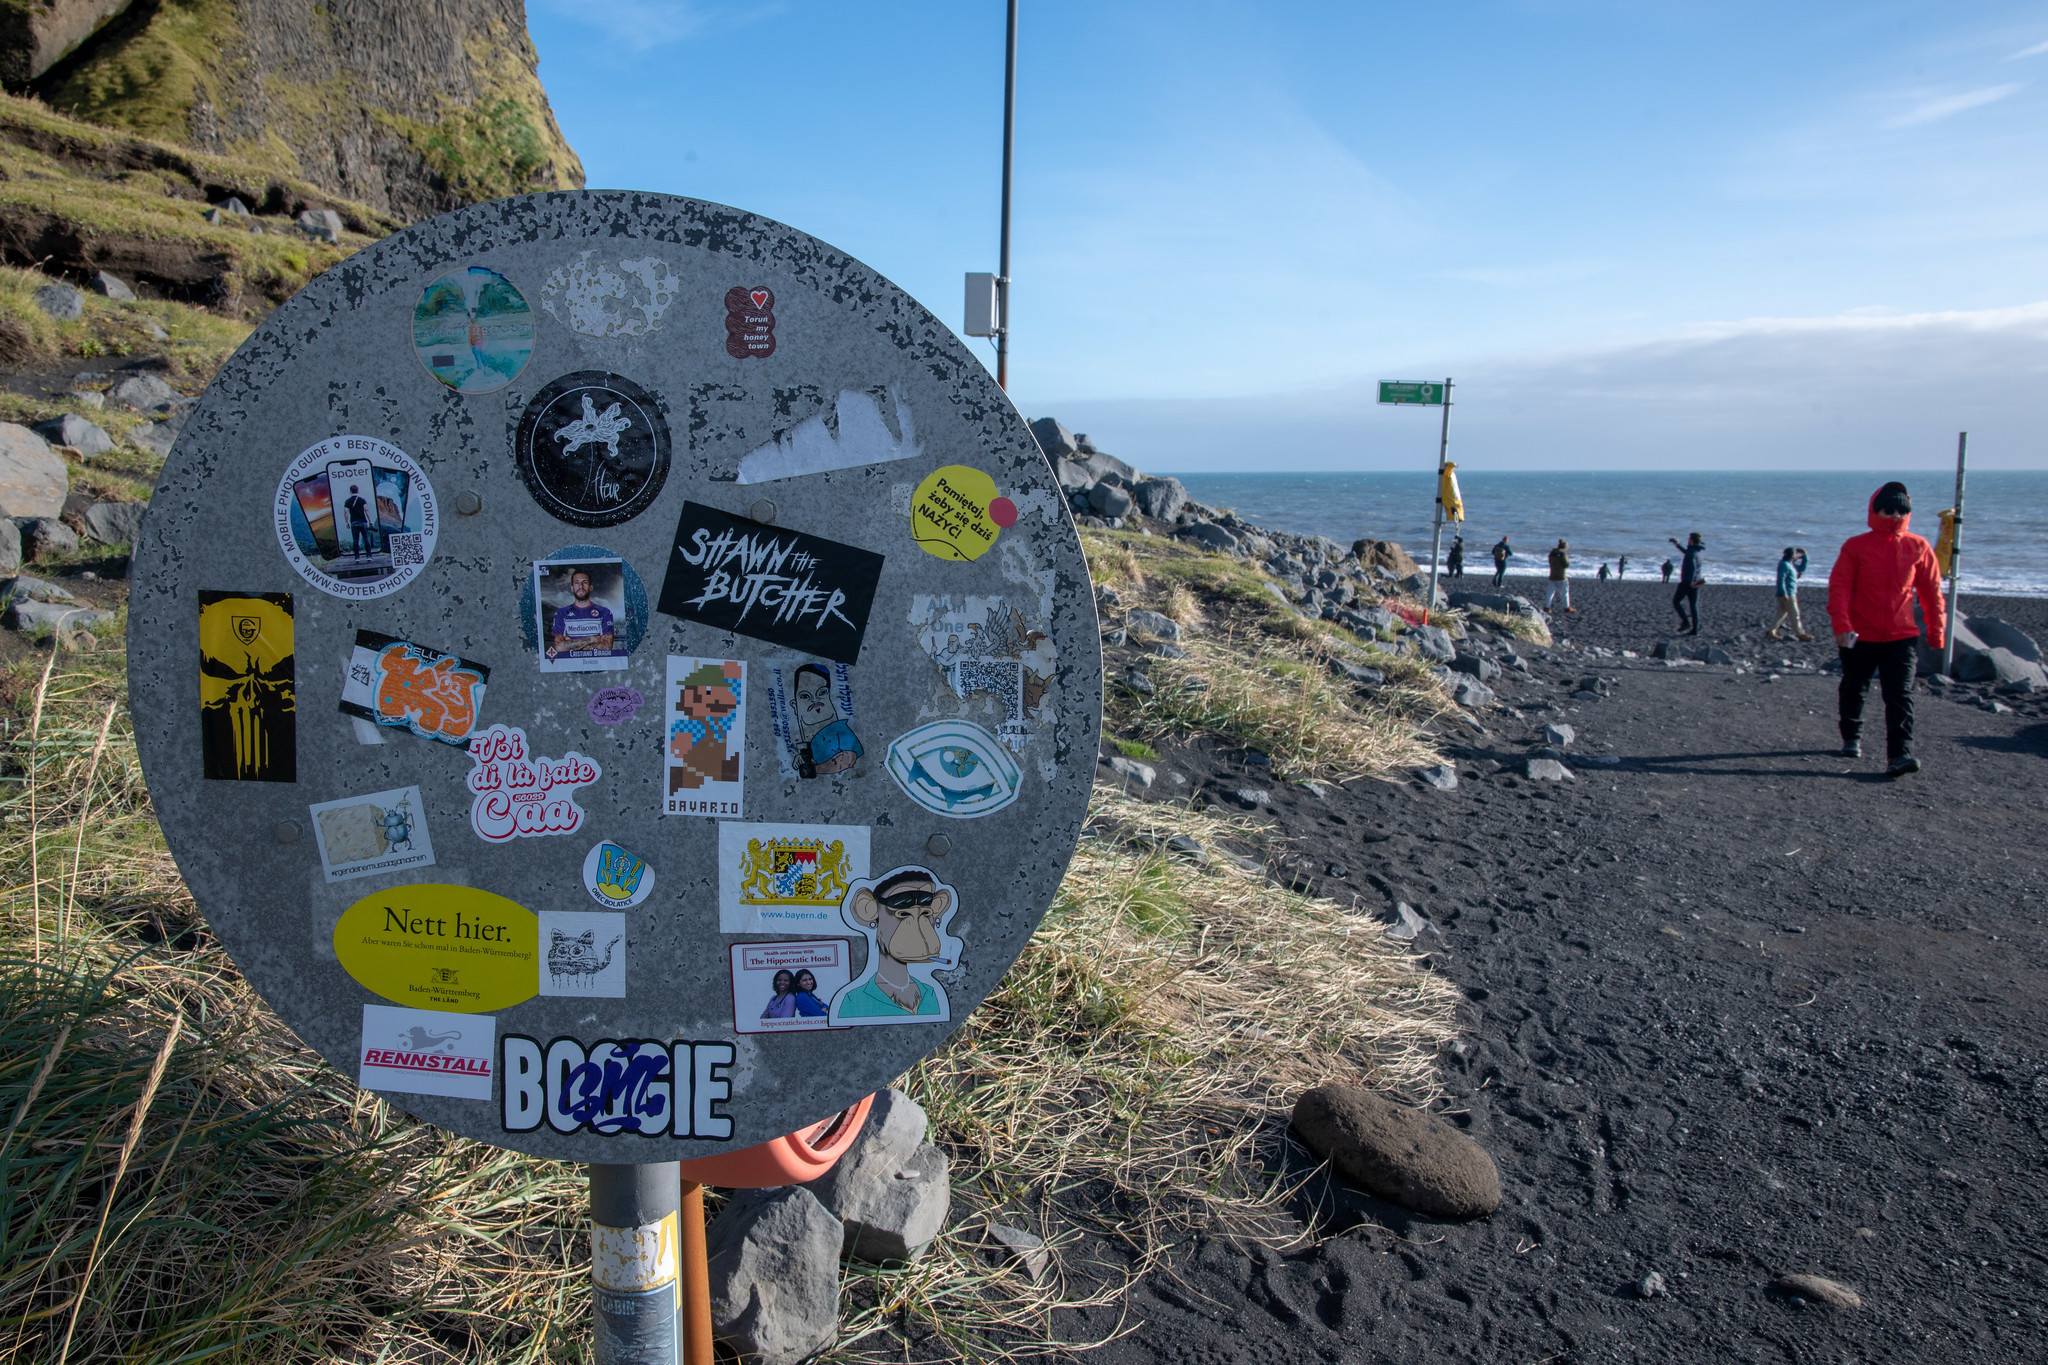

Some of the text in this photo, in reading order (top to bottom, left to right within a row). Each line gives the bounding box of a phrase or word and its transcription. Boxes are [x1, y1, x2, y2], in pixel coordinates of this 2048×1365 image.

[744, 315, 769, 323] Toruń
[755, 325, 769, 333] my
[743, 333, 769, 341] honey
[331, 467, 369, 480] spoter
[277, 444, 330, 553] MOBILE PHOTO GUIDE
[347, 439, 434, 537] BEST SHOOTING POINTS
[936, 477, 985, 520] Pamiętaj,
[918, 503, 962, 539] NAŻYĆ!
[928, 490, 994, 541] żeby się dziś
[678, 527, 823, 576] SHAWN THE
[303, 566, 413, 597] WWW.SPOTER.PHOTO
[682, 567, 857, 632] BUTCHER
[568, 623, 599, 633] Mediacom
[469, 730, 524, 764] Voi
[472, 757, 596, 791] di là fate
[668, 800, 738, 814] BAVARIO
[591, 887, 634, 908] OBEC BOLATICE
[383, 906, 512, 943] Nett hier.
[760, 911, 828, 920] www.bayern.de
[361, 936, 380, 945] Aber
[381, 939, 402, 947] waren
[402, 940, 413, 948] Sie
[413, 941, 435, 950] schon
[435, 943, 449, 951] mal
[459, 945, 532, 961] Baden-Württemberg?
[766, 956, 809, 965] Hippocratic
[810, 955, 831, 963] Hosts
[408, 984, 481, 1000] Baden-Württemberg
[760, 1019, 827, 1028] hippocratichosts.com
[365, 1049, 492, 1073] RENNSTALL
